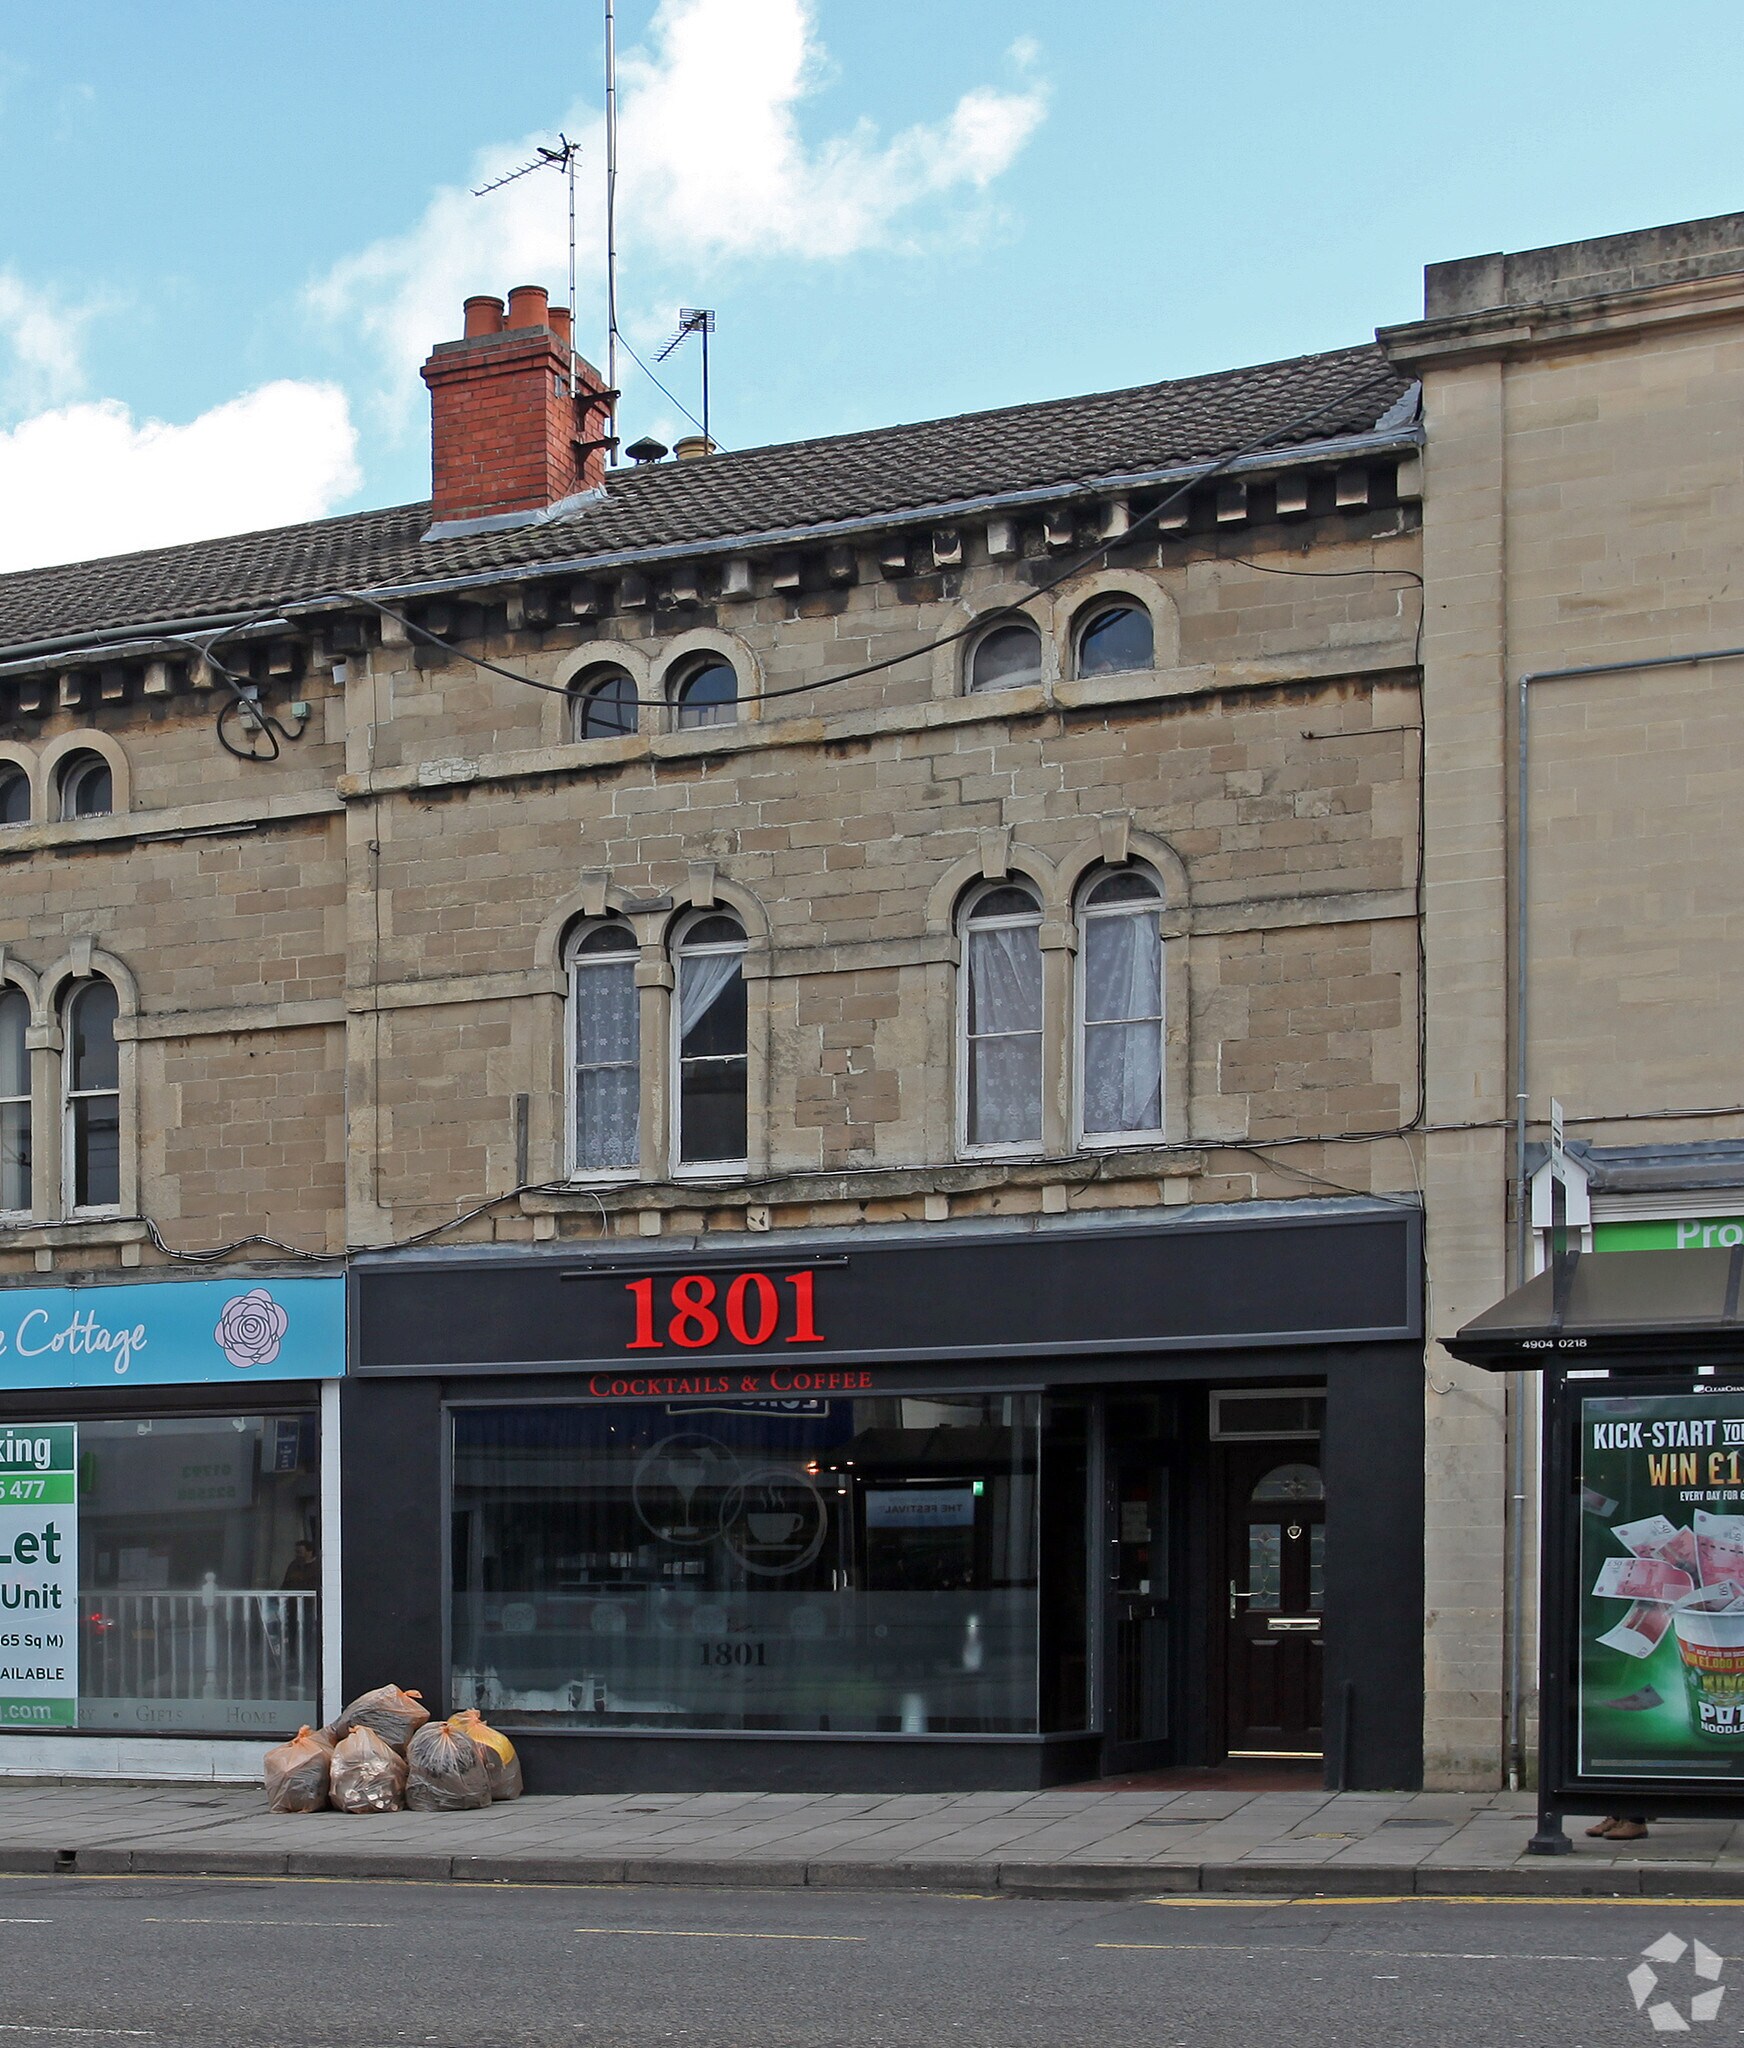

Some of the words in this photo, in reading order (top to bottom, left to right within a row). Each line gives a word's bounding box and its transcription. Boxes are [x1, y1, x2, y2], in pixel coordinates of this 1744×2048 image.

[625, 1270, 825, 1349] 1801
[15, 1309, 148, 1375] Cottage
[1522, 1340, 1554, 1349] 4904
[1558, 1339, 1587, 1348] 0218
[741, 1376, 758, 1392] &
[1593, 1420, 1716, 1449] KICK-START
[1648, 1453, 1697, 1487] WIN
[9, 1480, 46, 1499] 477
[1680, 1490, 1704, 1501] EVERY
[1706, 1490, 1721, 1500] DAY
[1723, 1489, 1738, 1500] FOR
[2, 1583, 62, 1609] Unit
[24, 1634, 42, 1649] Sq
[46, 1634, 64, 1648] M)
[700, 1642, 766, 1667] 1801
